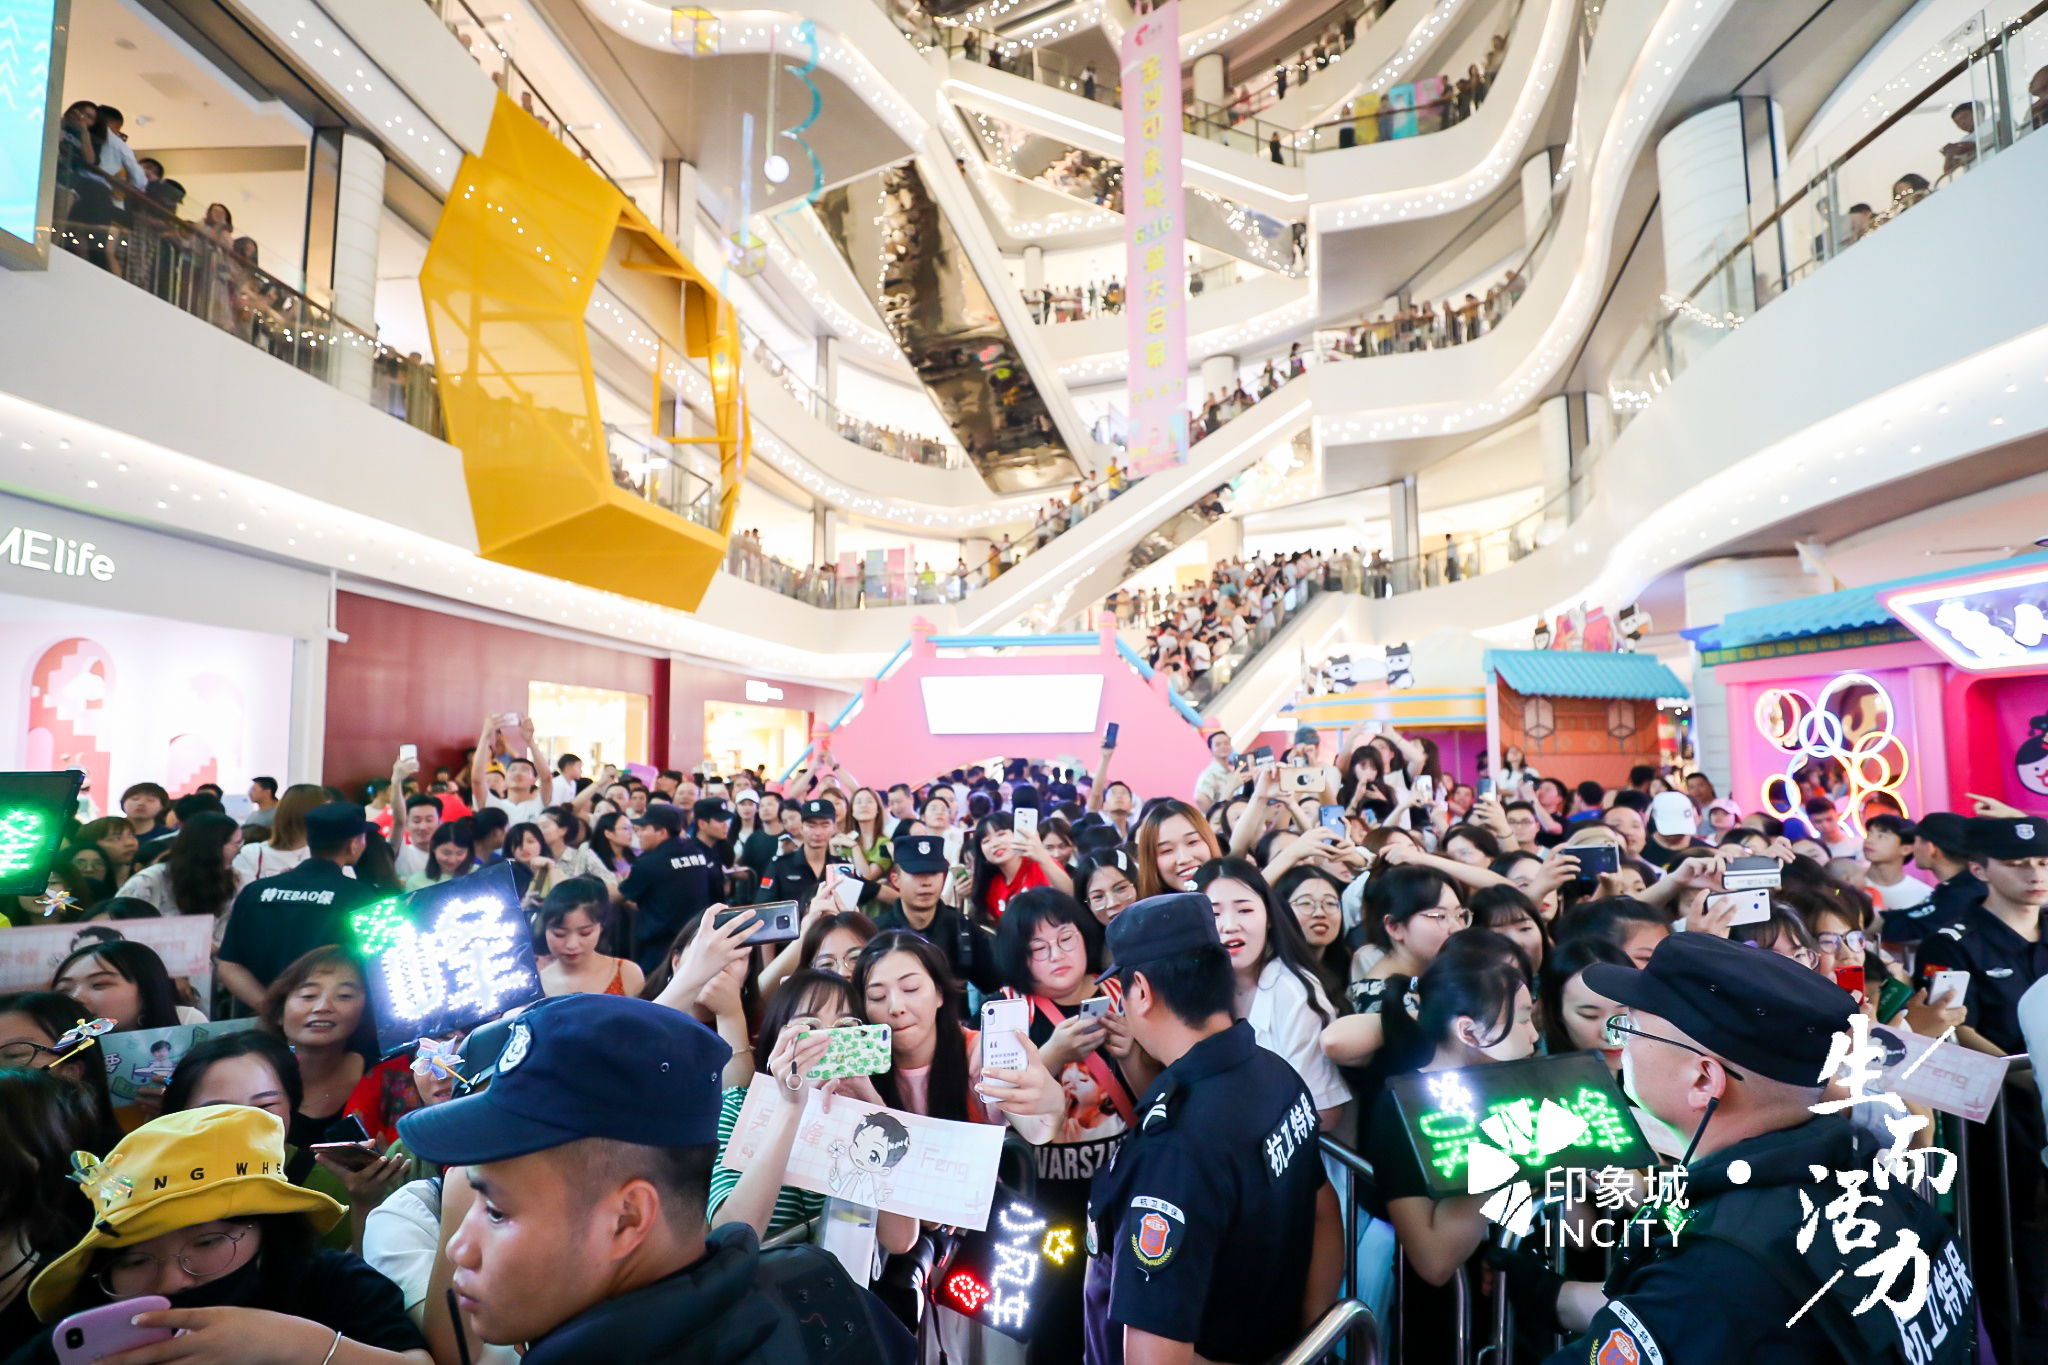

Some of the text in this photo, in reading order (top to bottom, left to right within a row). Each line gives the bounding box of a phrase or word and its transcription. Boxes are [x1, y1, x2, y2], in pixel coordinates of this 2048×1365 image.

[1266, 1092, 1316, 1178] 杭卫特保
[918, 1146, 971, 1181] Feng
[1139, 1198, 1179, 1218] 杭卫特保
[1618, 1307, 1659, 1361] 杭卫特保
